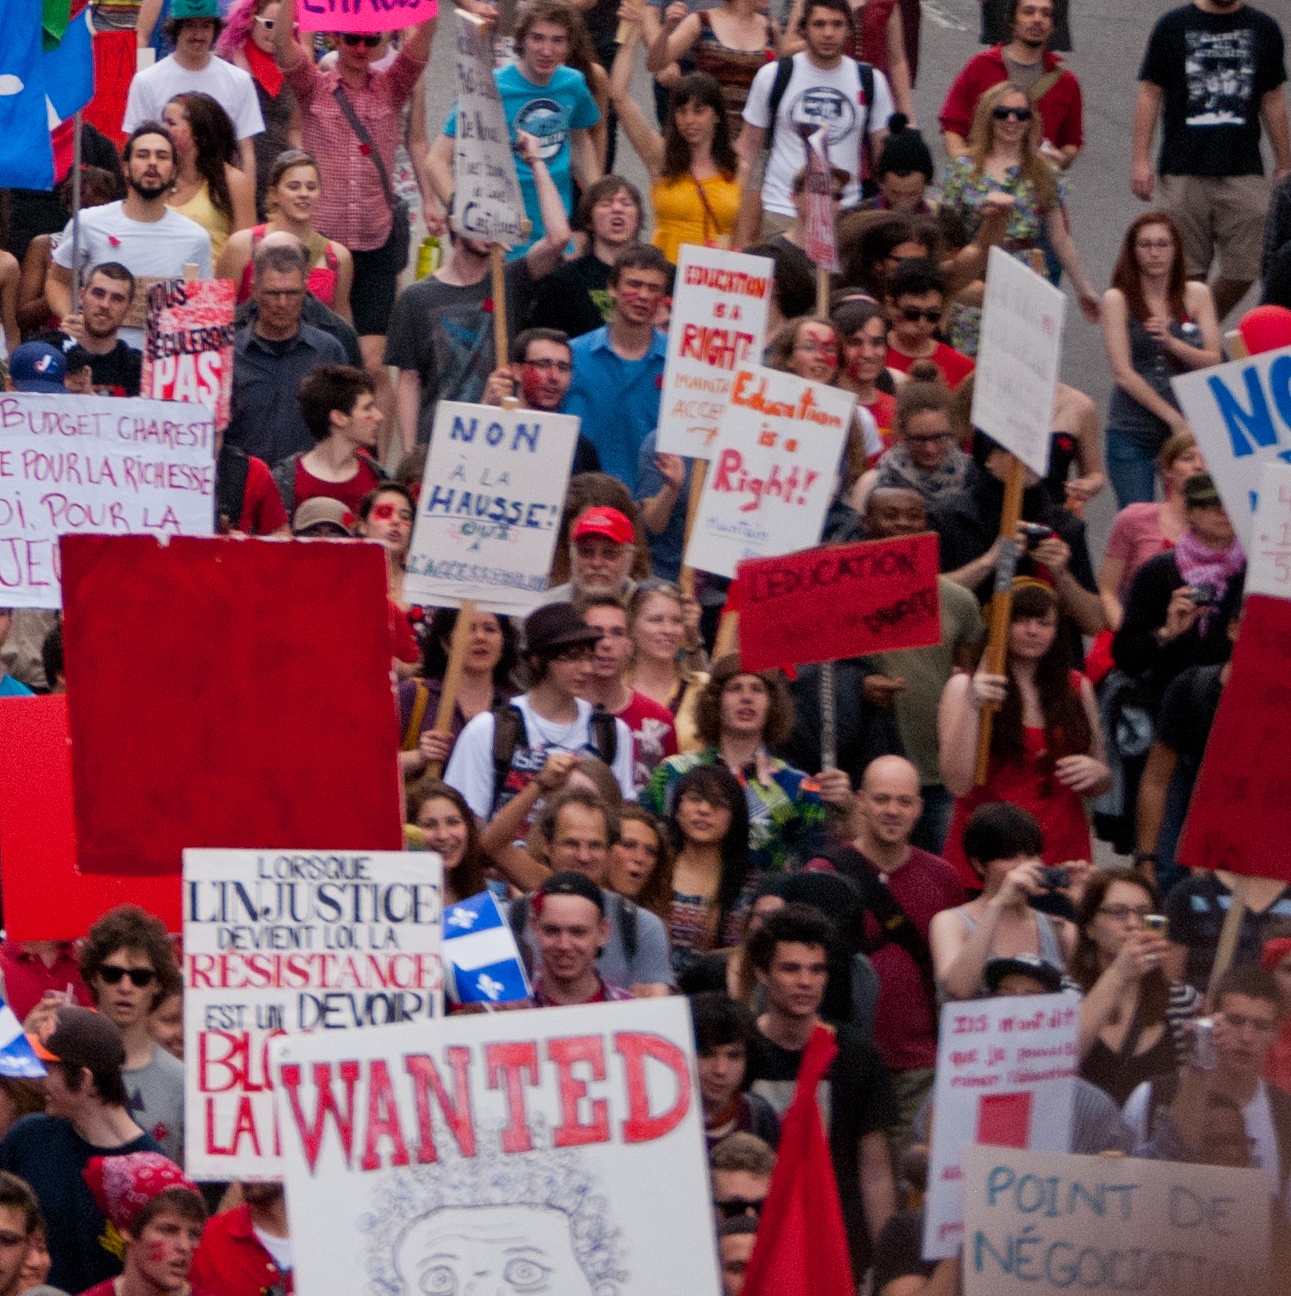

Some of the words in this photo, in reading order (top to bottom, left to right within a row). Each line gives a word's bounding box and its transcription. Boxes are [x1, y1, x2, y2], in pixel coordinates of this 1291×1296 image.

[684, 264, 770, 300] EDUCATION
[0, 398, 112, 437] BUDGET
[119, 415, 214, 449] CHAREST
[450, 415, 541, 452] NON
[22, 449, 82, 484] POUR
[87, 456, 117, 487] LA
[713, 448, 819, 512] Right!
[41, 493, 131, 533] POUR
[142, 506, 181, 534] LA
[257, 856, 371, 879] LORSQUE
[187, 881, 440, 924] L'INJUSTICE
[219, 925, 317, 949] DEVIENT
[367, 925, 396, 949] LA
[205, 1006, 248, 1030] EST
[254, 1004, 289, 1029] UN
[280, 1029, 693, 1173] WANTED
[206, 1103, 257, 1155] LA
[987, 1165, 1142, 1221] POINT
